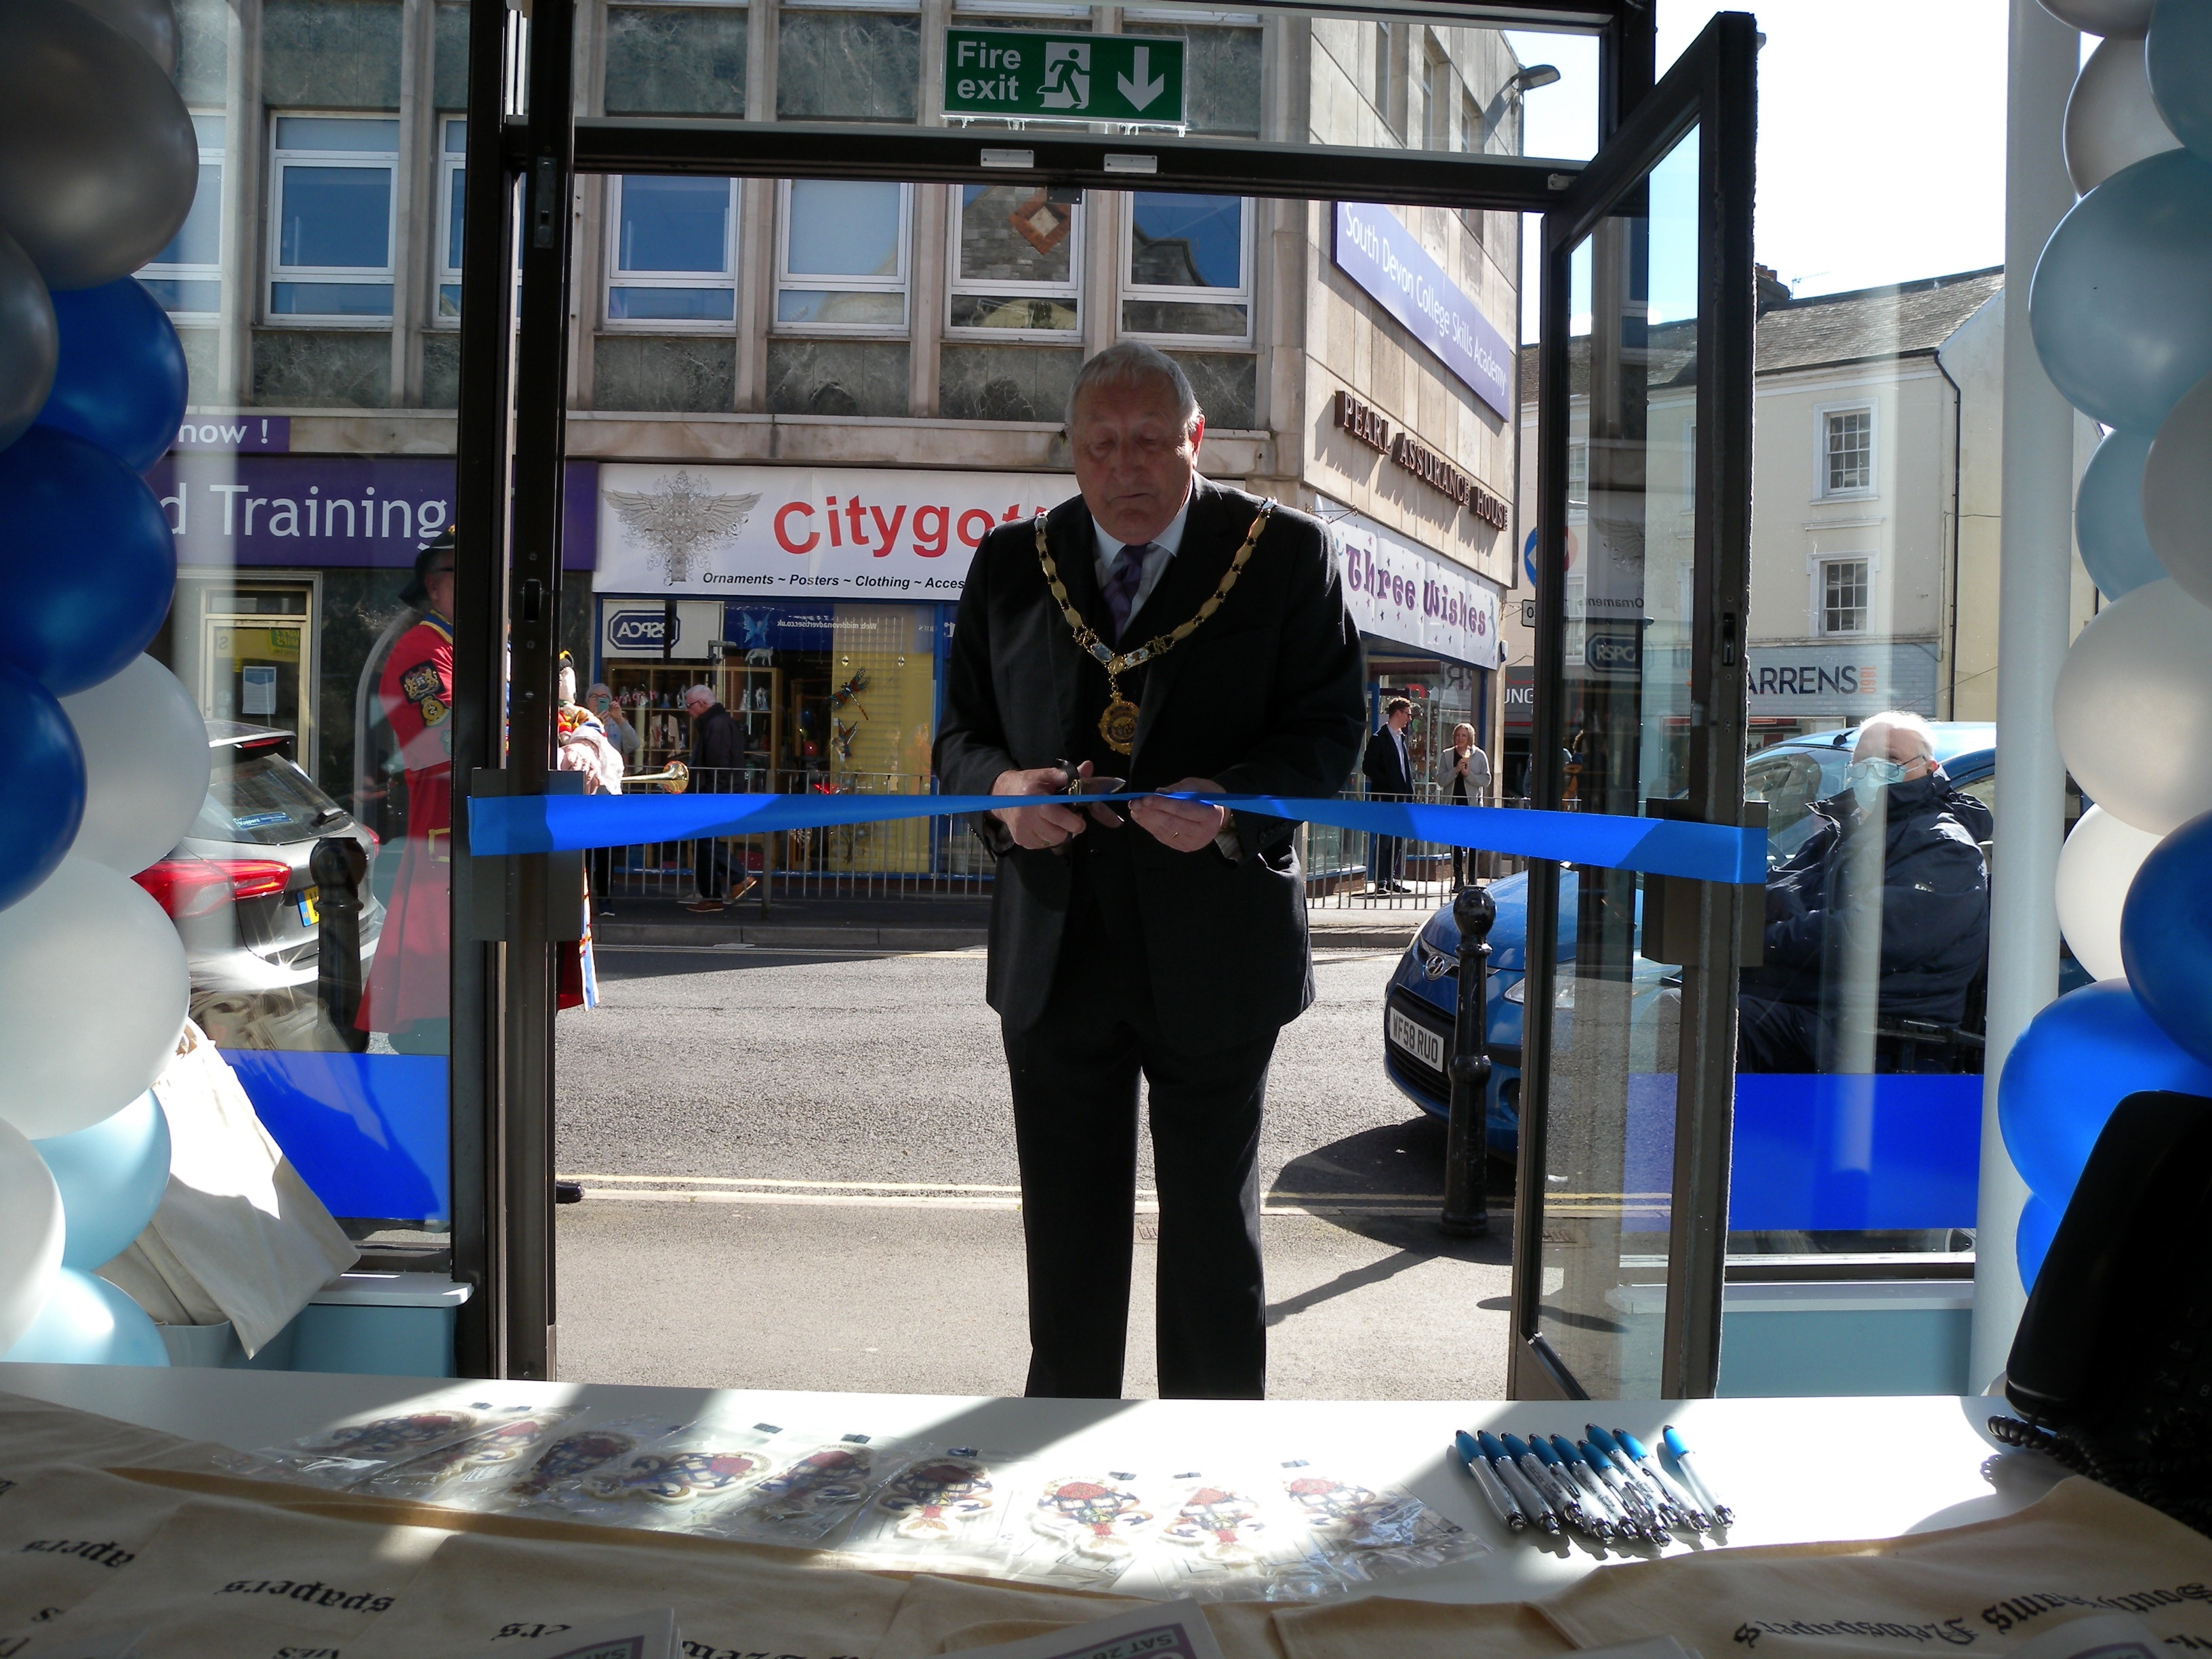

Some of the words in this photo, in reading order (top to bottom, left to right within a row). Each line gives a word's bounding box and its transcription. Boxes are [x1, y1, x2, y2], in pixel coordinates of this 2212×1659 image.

[957, 41, 1021, 70] Fire
[957, 75, 1019, 101] exit
[1345, 203, 1379, 264] South
[1382, 238, 1414, 299] Devon
[1416, 275, 1450, 337] College
[1452, 312, 1473, 357] Skills
[1474, 336, 1508, 395] Academy
[178, 424, 247, 444] now
[1343, 392, 1392, 455] PEARL
[1399, 437, 1471, 506] ASSURANCE
[1477, 487, 1509, 531] HOUSE
[210, 483, 447, 551] Training
[703, 572, 774, 586] Ornaments
[790, 573, 840, 587] Posters
[855, 574, 911, 590] Clothing
[1346, 542, 1417, 610] Three
[1423, 579, 1486, 637] Wishes
[1393, 1012, 1415, 1048] WF58
[1130, 1635, 1172, 1652] SAT
